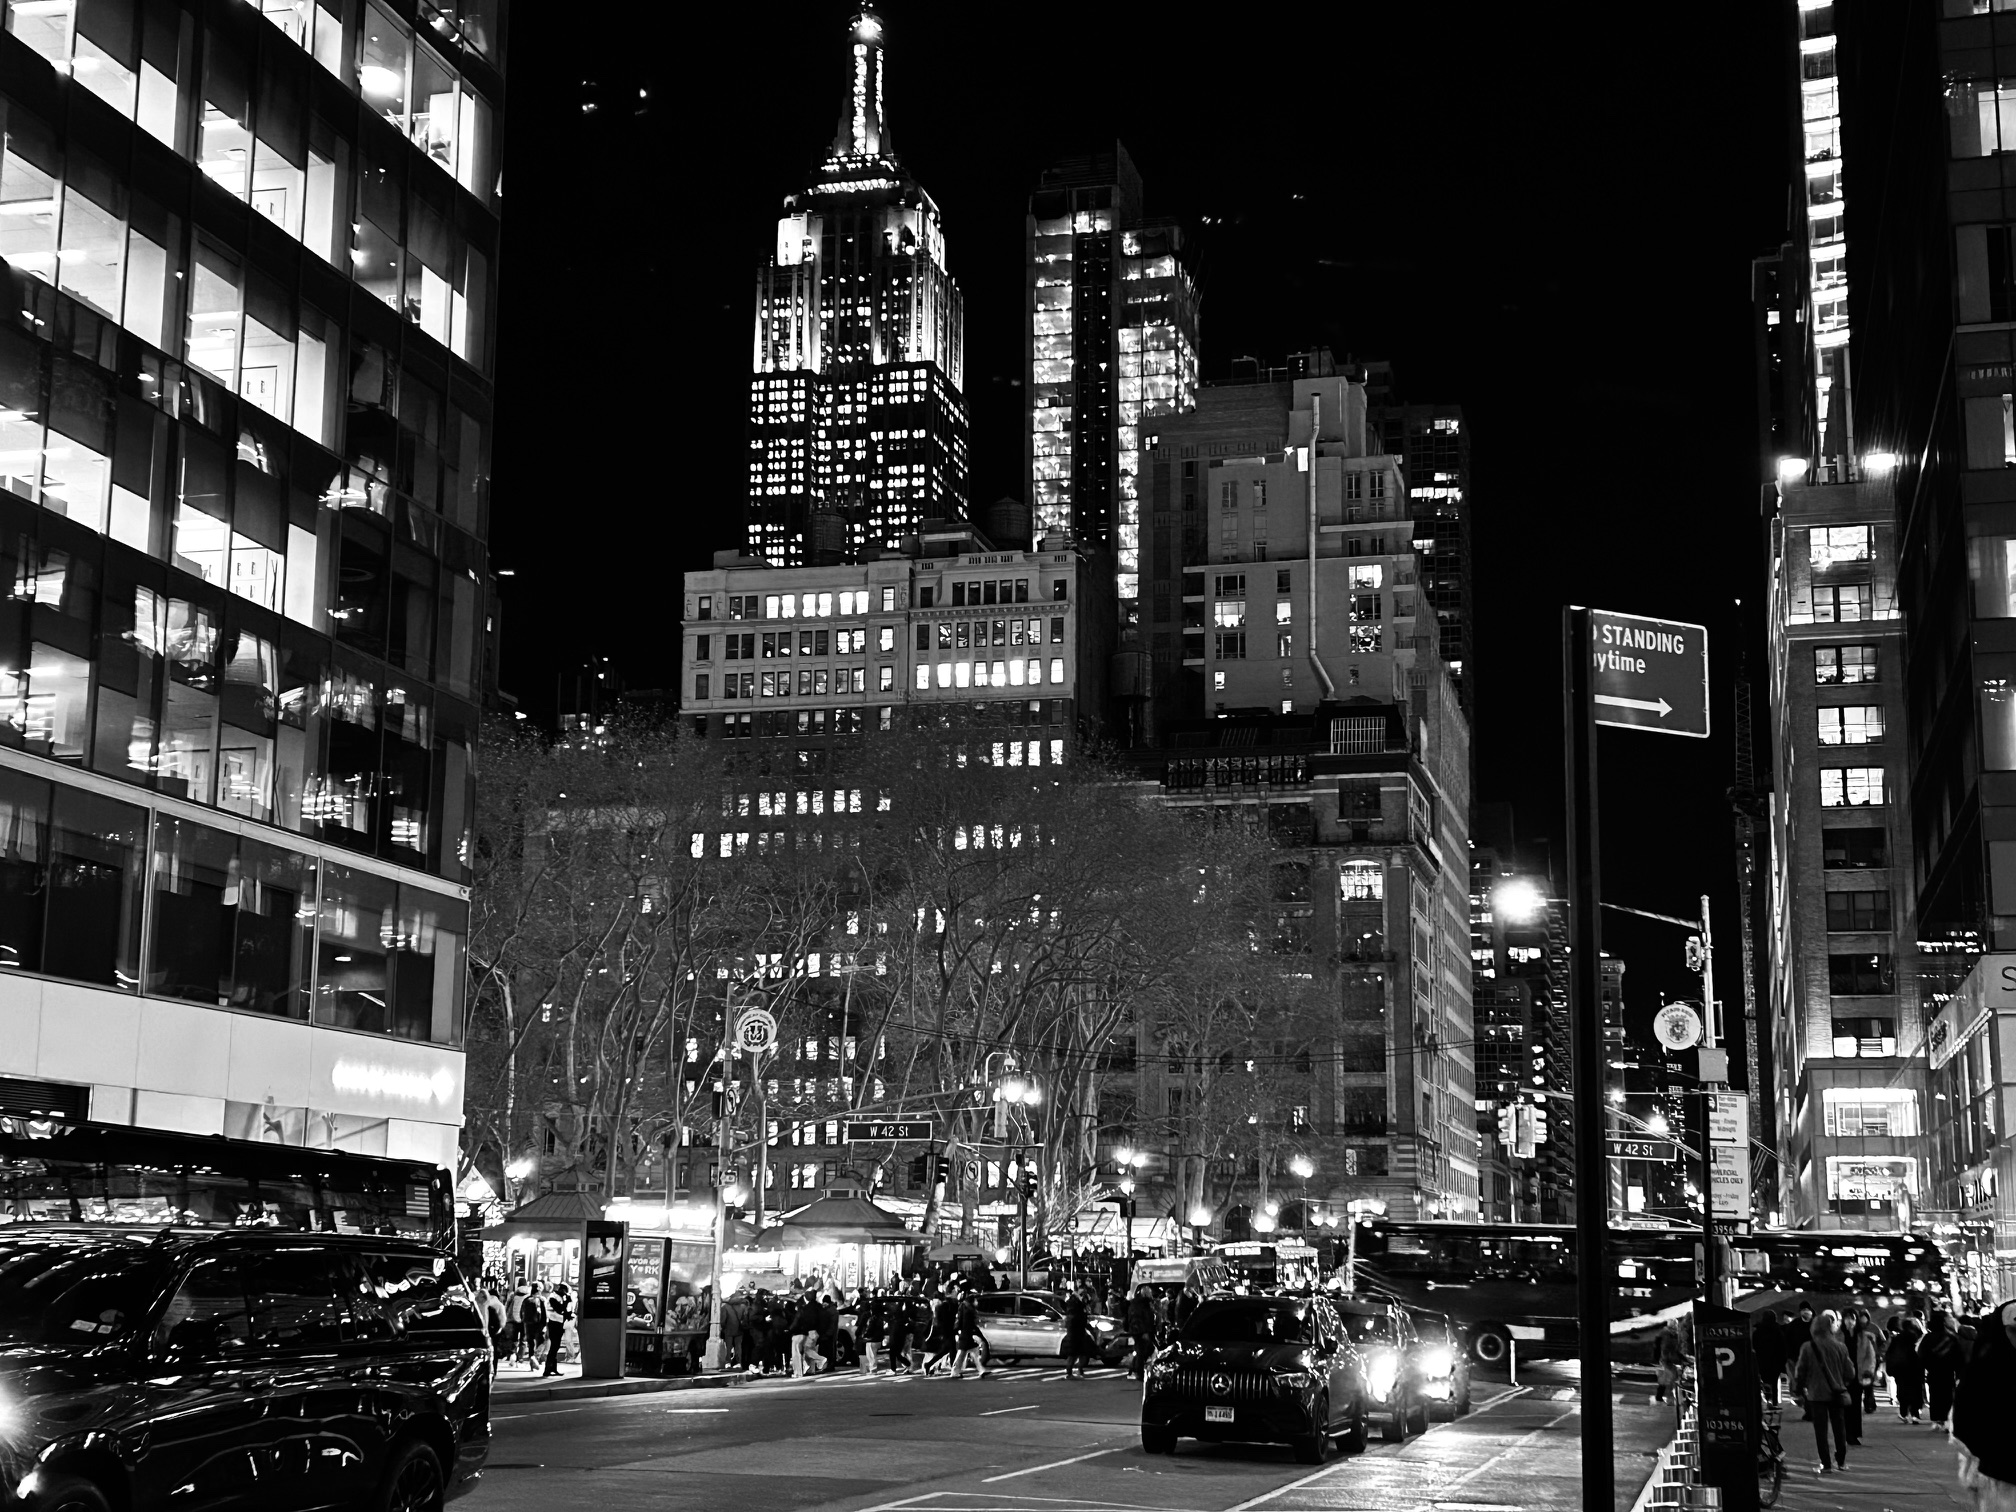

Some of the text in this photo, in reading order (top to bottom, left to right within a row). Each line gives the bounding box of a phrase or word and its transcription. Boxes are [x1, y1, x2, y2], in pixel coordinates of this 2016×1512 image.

[1602, 624, 1684, 655] STANDING
[1593, 650, 1646, 674] ytime
[869, 1125, 909, 1137] W 42 St
[1613, 1142, 1653, 1156] W 42 St
[1713, 1224, 1734, 1235] 3956
[1714, 1347, 1736, 1380] P
